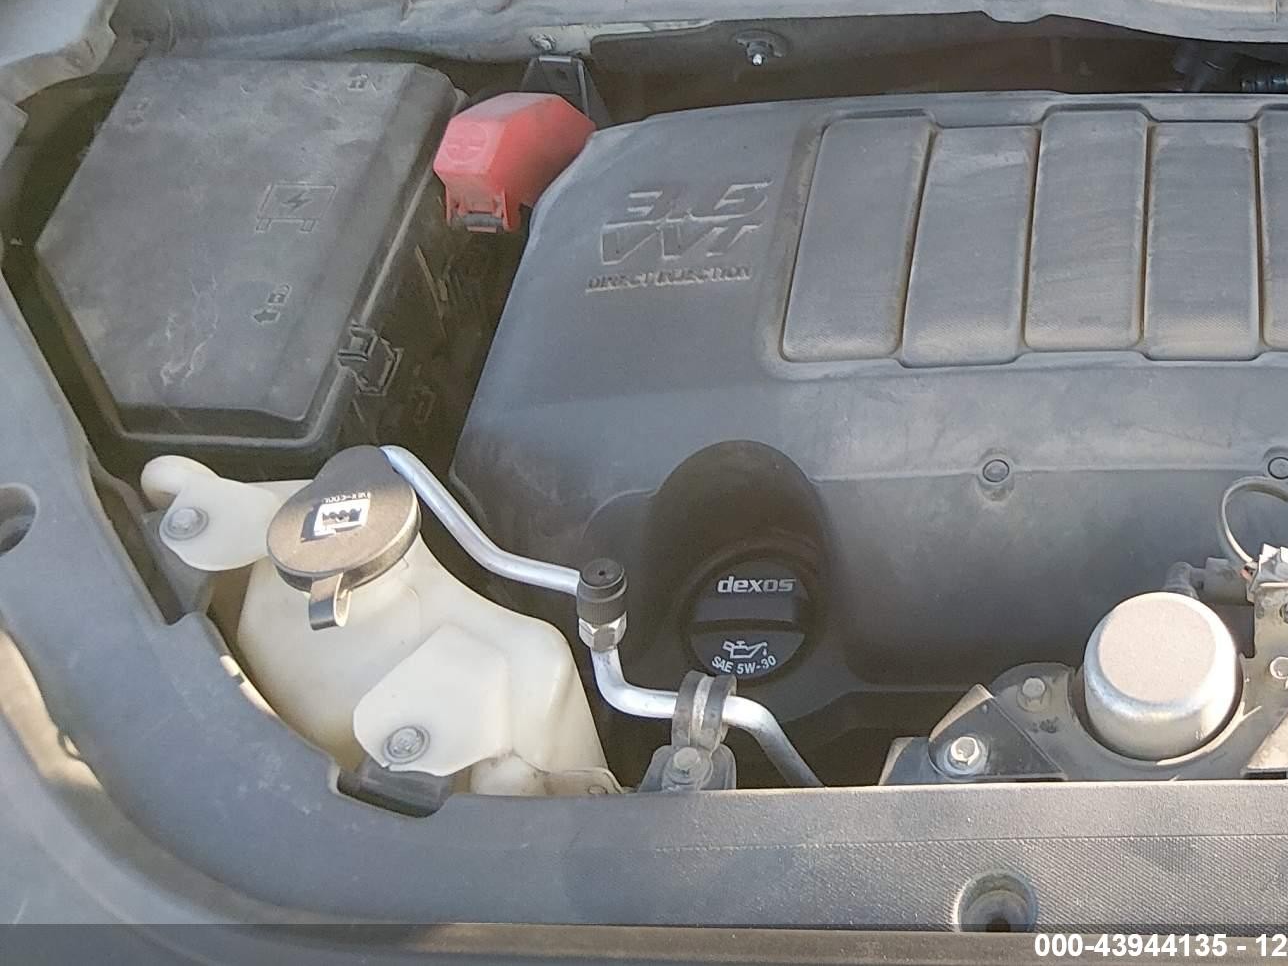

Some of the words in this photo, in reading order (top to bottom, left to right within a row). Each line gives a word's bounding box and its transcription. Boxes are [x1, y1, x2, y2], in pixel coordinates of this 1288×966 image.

[602, 181, 774, 228] 3.6
[717, 576, 797, 593] dexos
[711, 655, 734, 673] SAE
[736, 655, 777, 674] 5W-30
